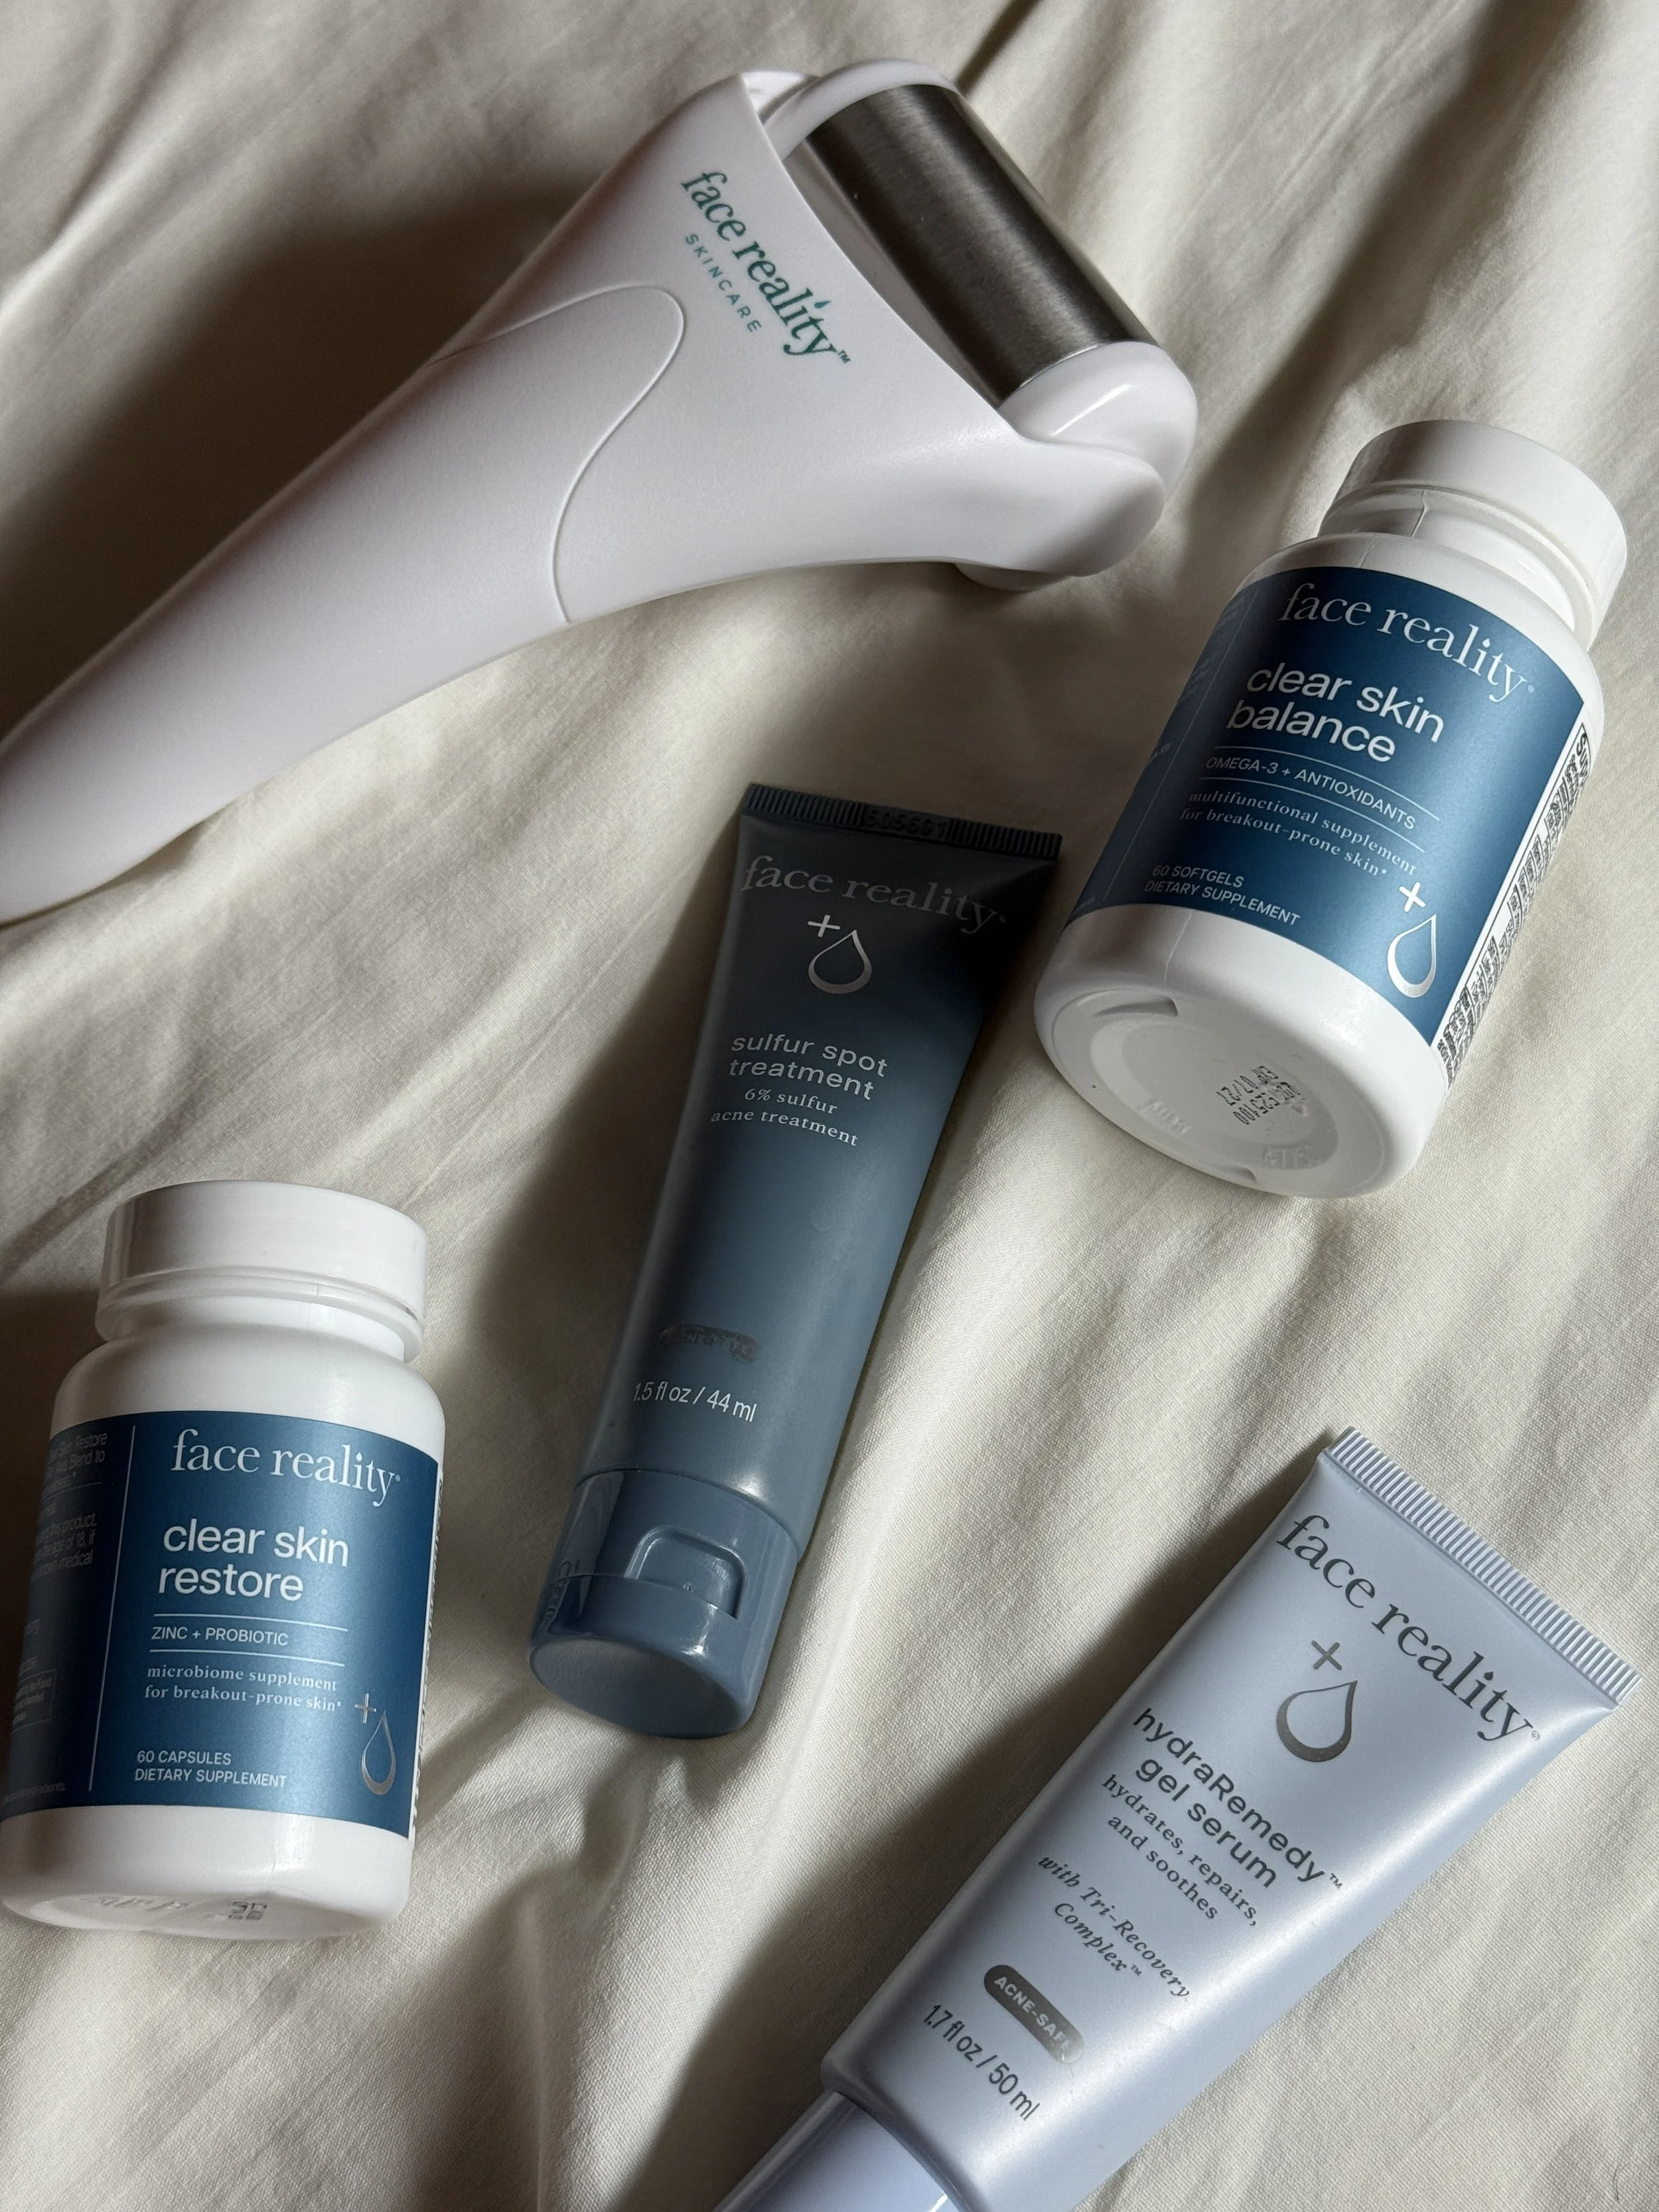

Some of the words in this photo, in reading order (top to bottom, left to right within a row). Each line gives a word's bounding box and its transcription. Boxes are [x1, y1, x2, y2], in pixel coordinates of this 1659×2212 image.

[681, 171, 746, 241] face
[685, 234, 762, 332] SKINCARE
[1278, 583, 1371, 625] face
[1247, 663, 1352, 701] clear
[1356, 687, 1444, 743] skin
[1226, 700, 1395, 763] balance
[1206, 757, 1278, 774] OMEGA-3
[1294, 769, 1416, 830] ANTIOXIDANTS
[1181, 808, 1202, 820] for
[1206, 810, 1340, 855] breakout-prone
[1189, 790, 1319, 824] multifunctional
[1321, 818, 1417, 876] supplement
[741, 855, 833, 893] face
[1153, 865, 1169, 877] 60
[1171, 867, 1244, 888] SOFTGELS
[1144, 881, 1200, 895] DIETARY
[1202, 886, 1300, 926] SUPPLEMENT
[731, 1033, 815, 1055] sulfur
[822, 1045, 888, 1078] spot
[729, 1059, 875, 1100] treatment
[745, 1088, 771, 1102] 6%
[776, 1093, 837, 1114] sulfur
[711, 1111, 755, 1122] acne
[760, 1110, 859, 1147] treatment
[633, 1381, 654, 1402] 1.5
[654, 1380, 668, 1400] fl
[668, 1386, 691, 1403] oz
[692, 1386, 706, 1404] /
[707, 1390, 731, 1412] 44
[732, 1400, 757, 1422] ml
[170, 1428, 261, 1473] face
[163, 1518, 265, 1554] clear
[273, 1526, 349, 1567] skin
[1276, 1515, 1375, 1608] face
[159, 1564, 303, 1601] restore
[151, 1627, 188, 1640] ZINC
[192, 1630, 201, 1639] +
[204, 1627, 289, 1646] PROBIOTIC
[145, 1685, 169, 1698] for
[173, 1686, 301, 1707] breakout-prone
[147, 1664, 244, 1680] microbiome
[249, 1672, 337, 1692] supplement
[135, 1769, 192, 1781] DIETARY
[195, 1770, 287, 1788] SUPPLEMENT
[137, 1751, 155, 1763] 60
[158, 1751, 232, 1765] CAPSULES
[1135, 1759, 1190, 1801] gel
[1187, 1803, 1276, 1887] serum
[1102, 1775, 1183, 1855] hydrates,
[1189, 1854, 1257, 1925] repairs,
[1108, 1816, 1148, 1850] and
[1146, 1850, 1218, 1919] soothes
[1038, 1856, 1080, 1887] with
[1080, 1887, 1189, 1997] Tri-Recovery
[923, 2004, 954, 2029] 1.7
[943, 2020, 965, 2041] fl
[956, 2035, 983, 2061] oz
[975, 2054, 997, 2069] /
[988, 2062, 1019, 2095] 50
[1009, 2091, 1041, 2121] ml
